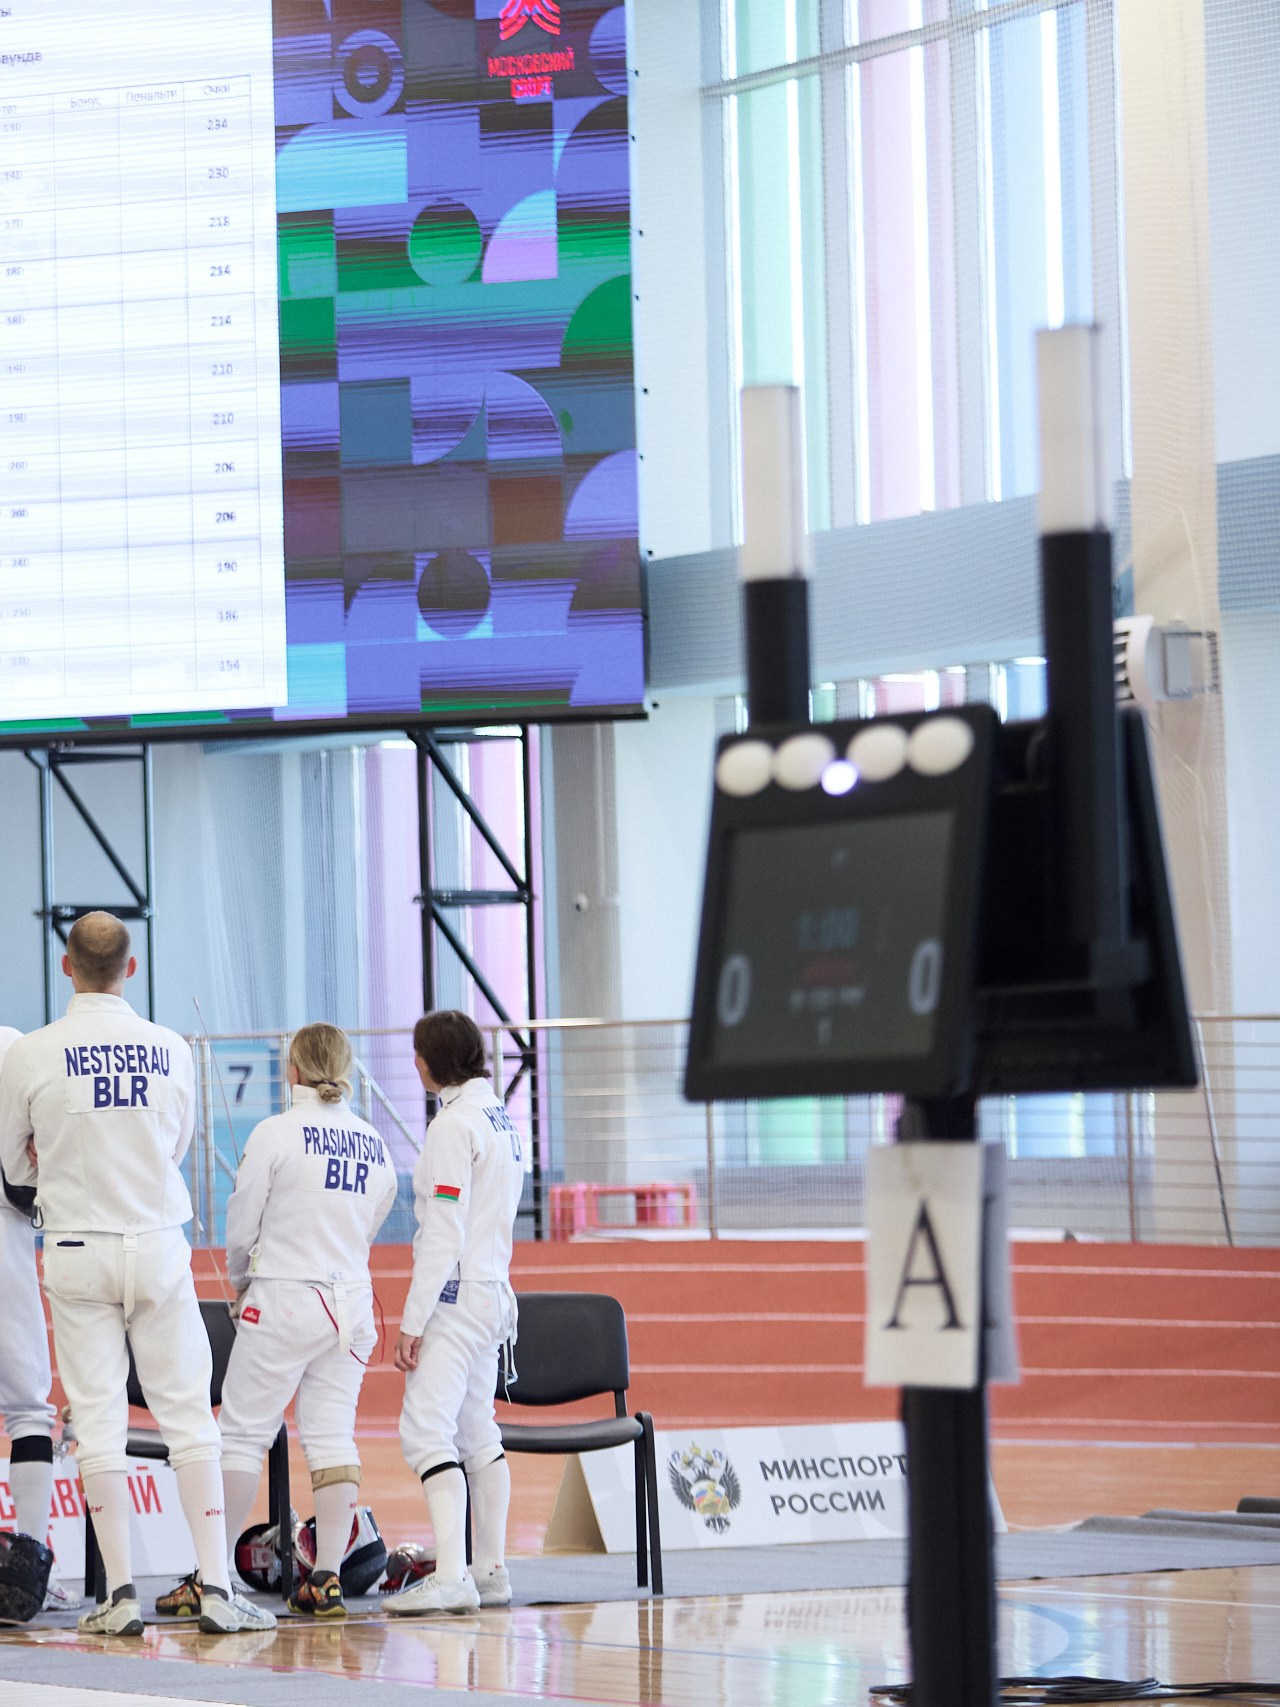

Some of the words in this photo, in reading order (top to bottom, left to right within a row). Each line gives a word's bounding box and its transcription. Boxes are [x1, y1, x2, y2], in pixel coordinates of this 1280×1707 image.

[126, 89, 178, 102] Пенальти
[202, 84, 231, 96] Очки
[70, 97, 102, 109] Бонус
[207, 118, 228, 131] 234
[208, 167, 229, 179] 230
[209, 216, 230, 228] 218
[210, 264, 231, 277] 214
[211, 315, 232, 327] 214
[212, 363, 233, 376] 210
[213, 412, 234, 425] 210
[215, 462, 236, 474] 206
[216, 511, 237, 523] 206
[217, 561, 238, 573] 190
[220, 660, 240, 672] 154
[909, 938, 942, 1016] 0
[720, 953, 751, 1028] 0
[65, 1044, 170, 1077] NESTSERAU
[228, 1065, 253, 1103] 7
[94, 1075, 149, 1108] BLR
[324, 1158, 369, 1194] BLR
[759, 1454, 907, 1480] МИНСПОРТ
[770, 1490, 886, 1516] РОССИИ
